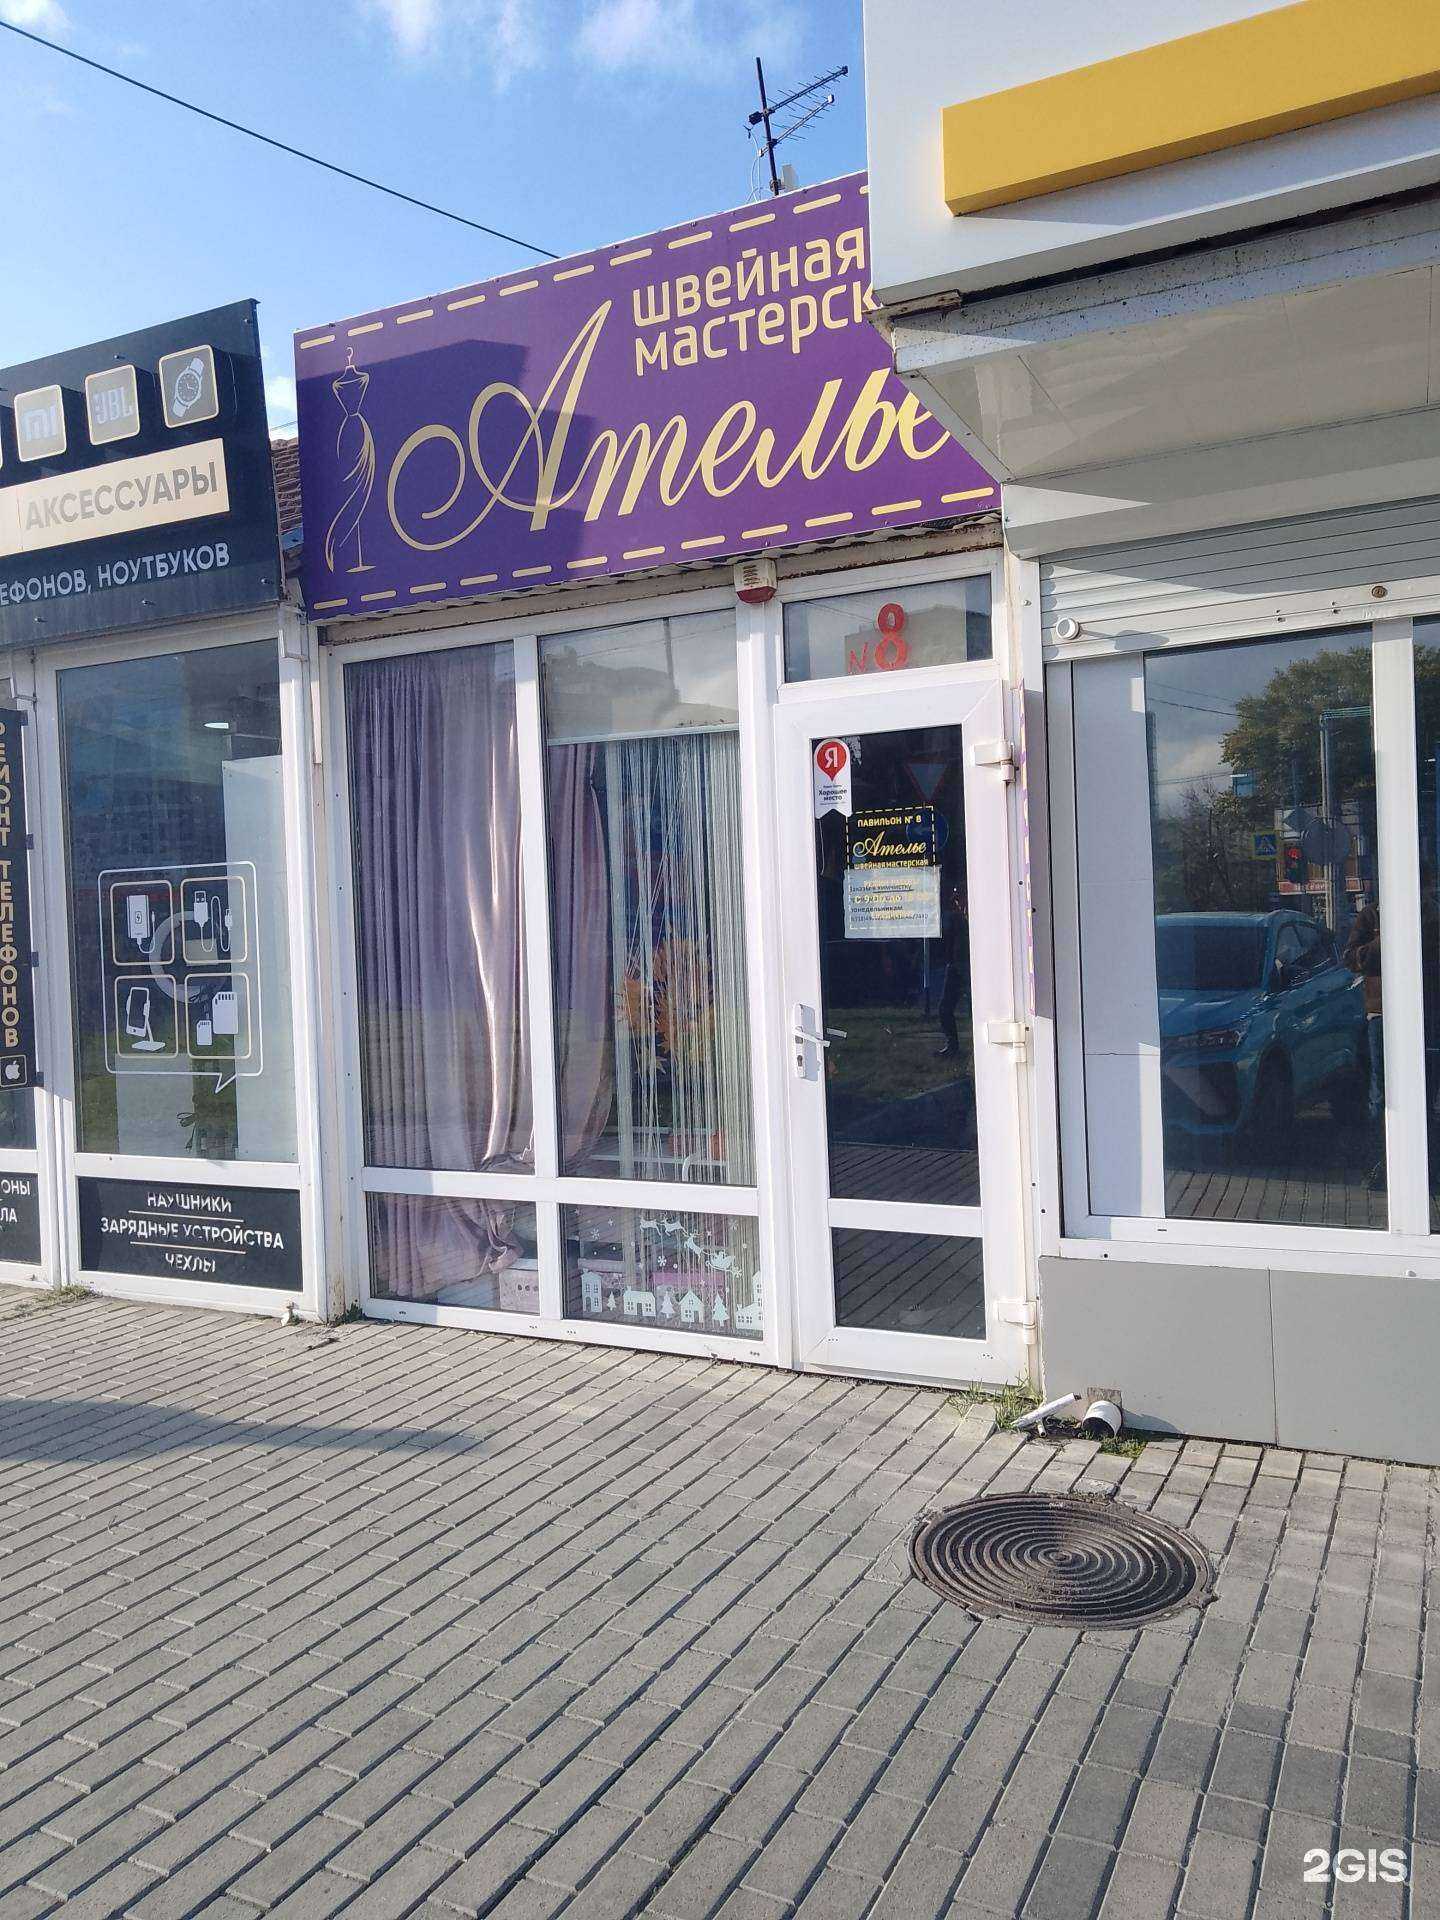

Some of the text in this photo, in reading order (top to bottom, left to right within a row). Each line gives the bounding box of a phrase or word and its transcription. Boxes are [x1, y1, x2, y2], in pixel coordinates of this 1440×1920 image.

[633, 227, 864, 327] швейная
[388, 301, 949, 551] Ателье
[25, 461, 219, 530] АКСЕССУАРЫ
[97, 542, 231, 588] НОУТБУКОВ
[825, 746, 838, 768] Я
[857, 815, 902, 828] ПАВИЛЬОН
[852, 830, 927, 858] Ателье
[0, 859, 20, 1048] ТЕЛЕФОНОВ
[147, 1191, 232, 1214] НАУШНИКИ
[100, 1216, 284, 1250] ЗАРЯДНЫЕ УСТРОЙСТВА
[165, 1253, 216, 1273] ЧЕХЛЫ
